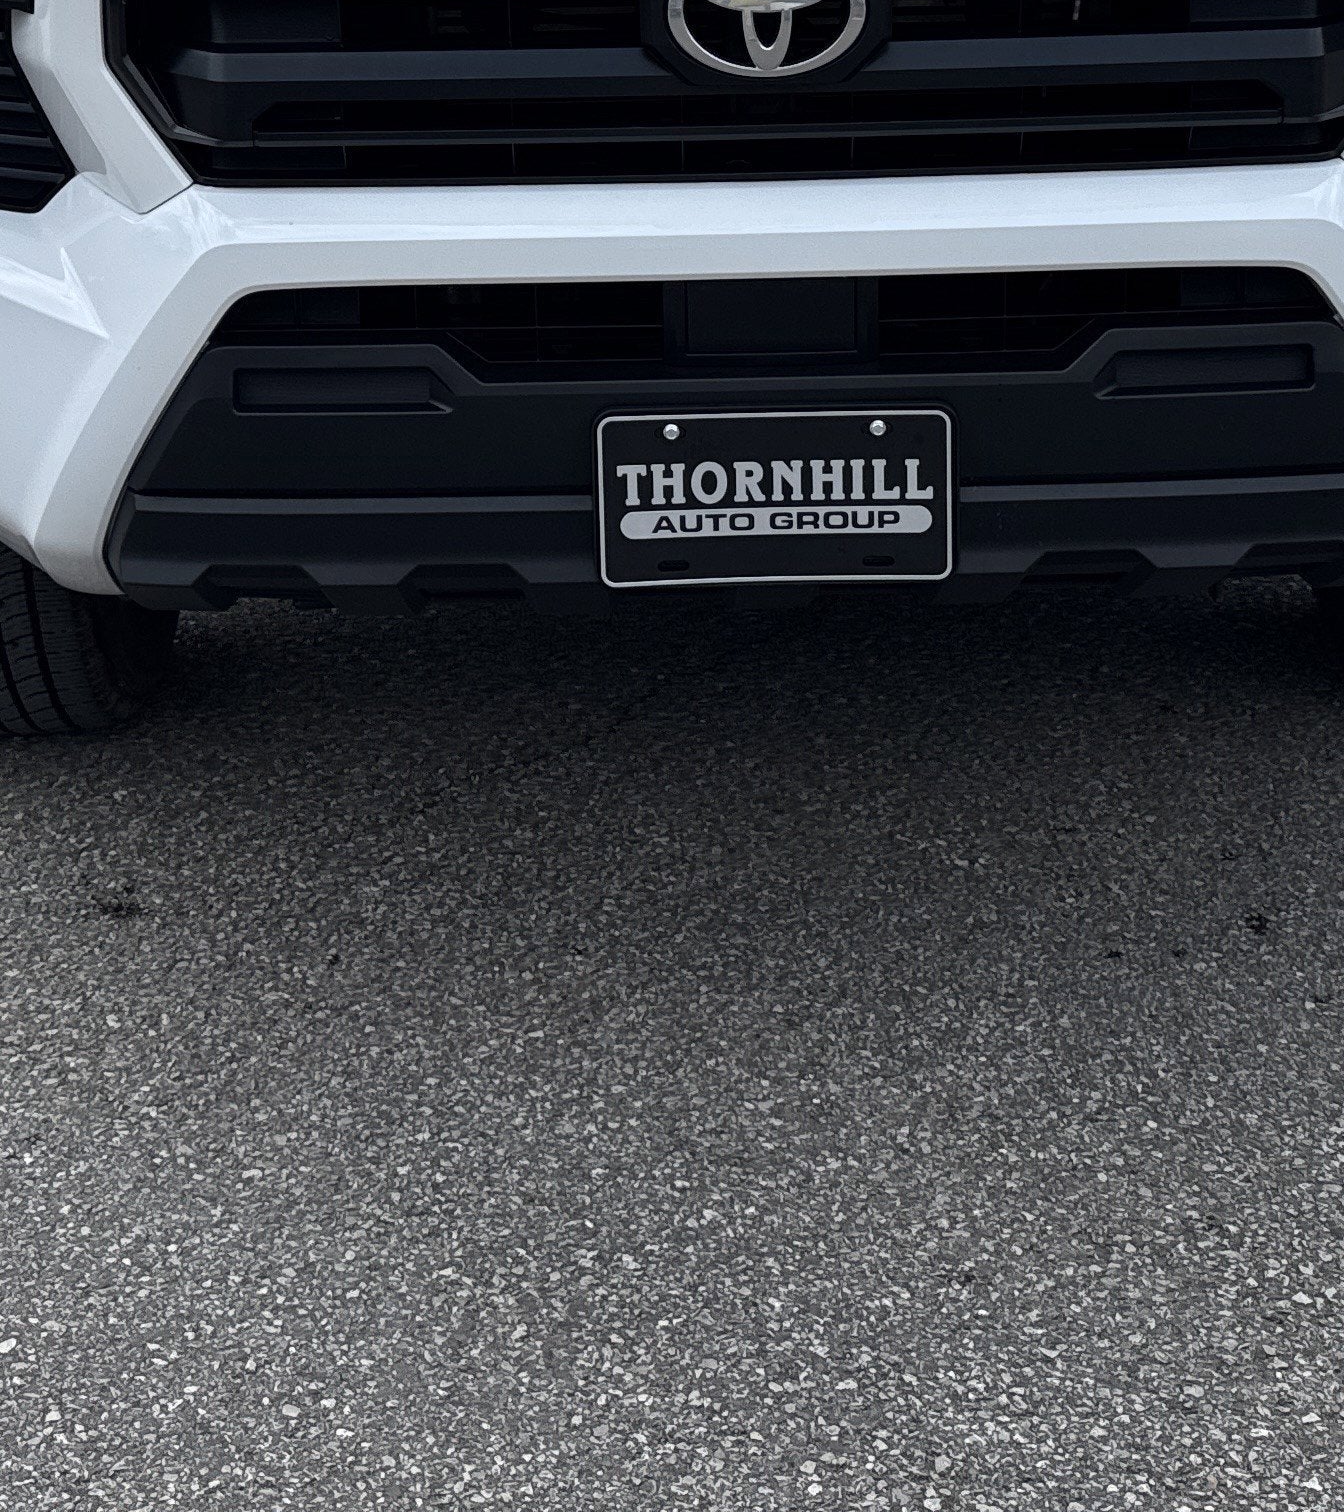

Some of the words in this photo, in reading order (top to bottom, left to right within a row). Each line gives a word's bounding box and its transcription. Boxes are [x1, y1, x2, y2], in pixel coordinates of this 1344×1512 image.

[616, 458, 934, 506] THORNHILL
[652, 512, 755, 534] AUTO
[769, 510, 901, 530] GROUP
